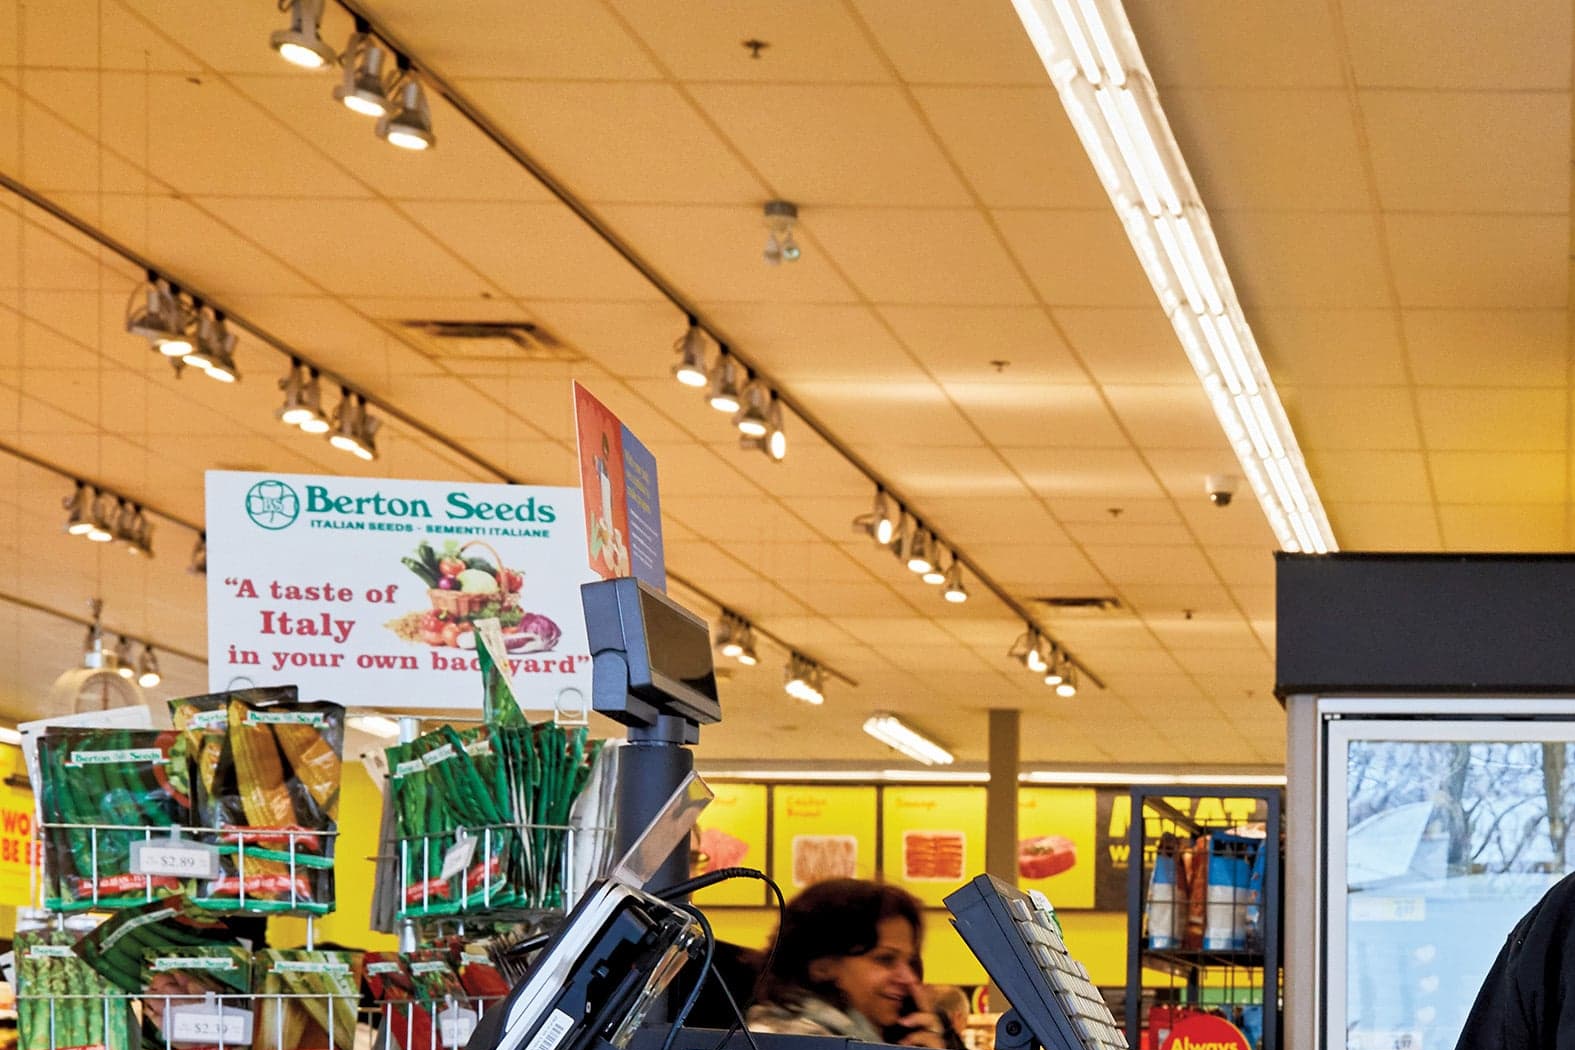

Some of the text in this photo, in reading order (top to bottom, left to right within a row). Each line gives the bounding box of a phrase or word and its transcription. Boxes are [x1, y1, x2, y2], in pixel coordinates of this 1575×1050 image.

[305, 485, 557, 523] Berton Seeds
[310, 519, 365, 531] ITALIAN
[368, 522, 414, 533] SEEDS
[426, 525, 486, 536] SEMENTI
[489, 528, 550, 539] ITALIANE
[270, 579, 353, 603] taste
[366, 584, 399, 604] of
[260, 611, 356, 644] Italy
[228, 645, 590, 674] in your own bacyard”
